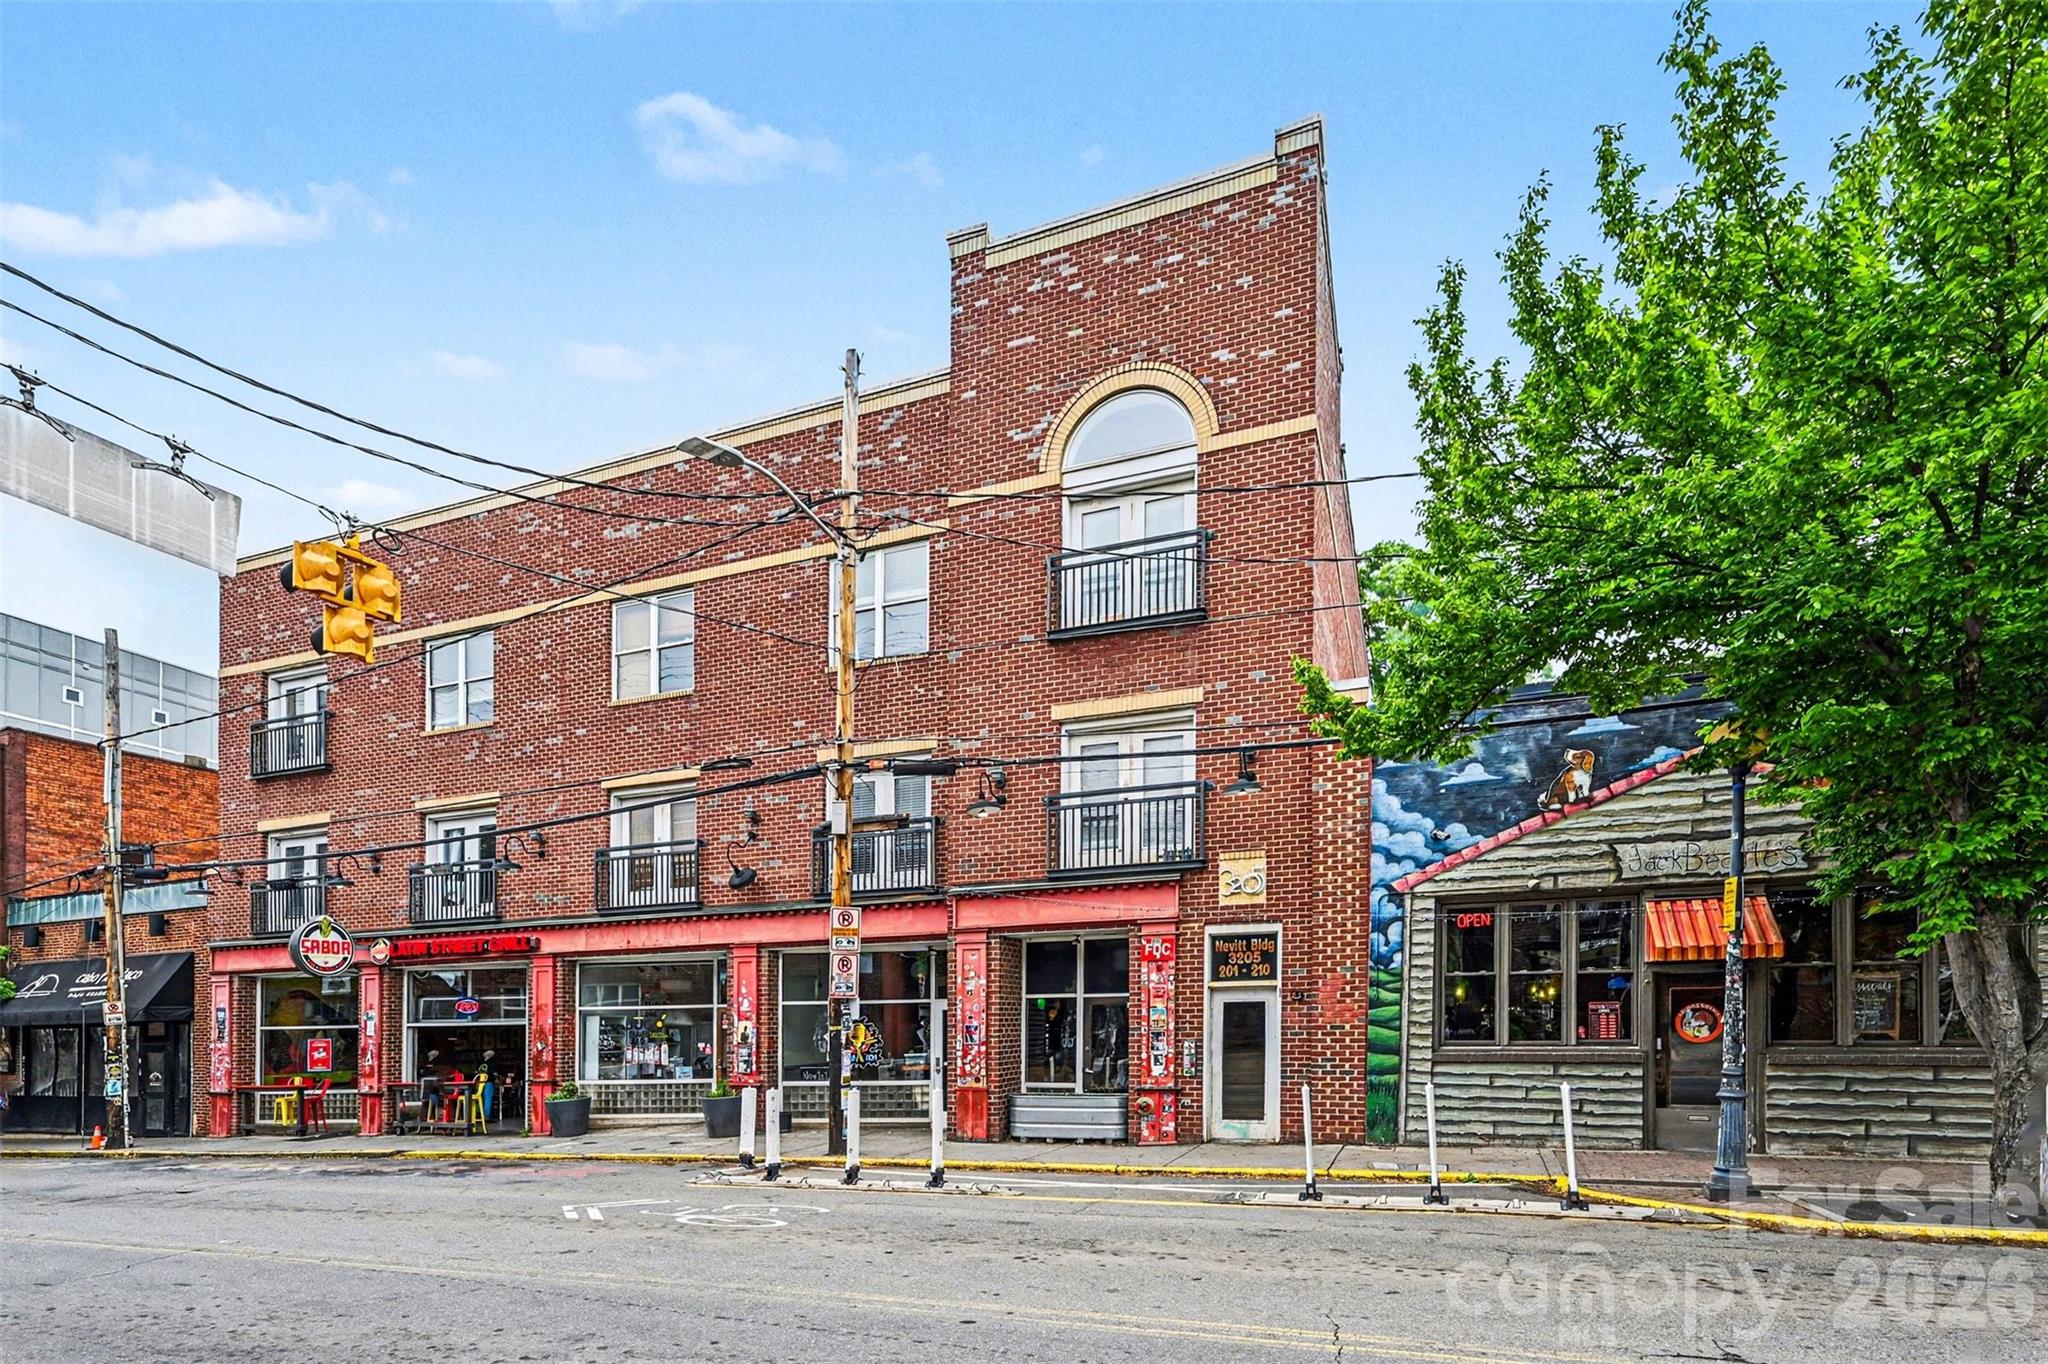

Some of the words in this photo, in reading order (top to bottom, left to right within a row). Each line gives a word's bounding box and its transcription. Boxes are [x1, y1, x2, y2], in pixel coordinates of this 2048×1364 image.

[1457, 913, 1491, 928] OPEN
[301, 938, 351, 955] SABOR
[432, 938, 486, 954] STREET
[1215, 939, 1247, 952] Nevitt
[1250, 938, 1275, 952] Bldg
[1228, 951, 1261, 964] 3205
[1218, 964, 1239, 978] 201
[1251, 963, 1271, 977] 210
